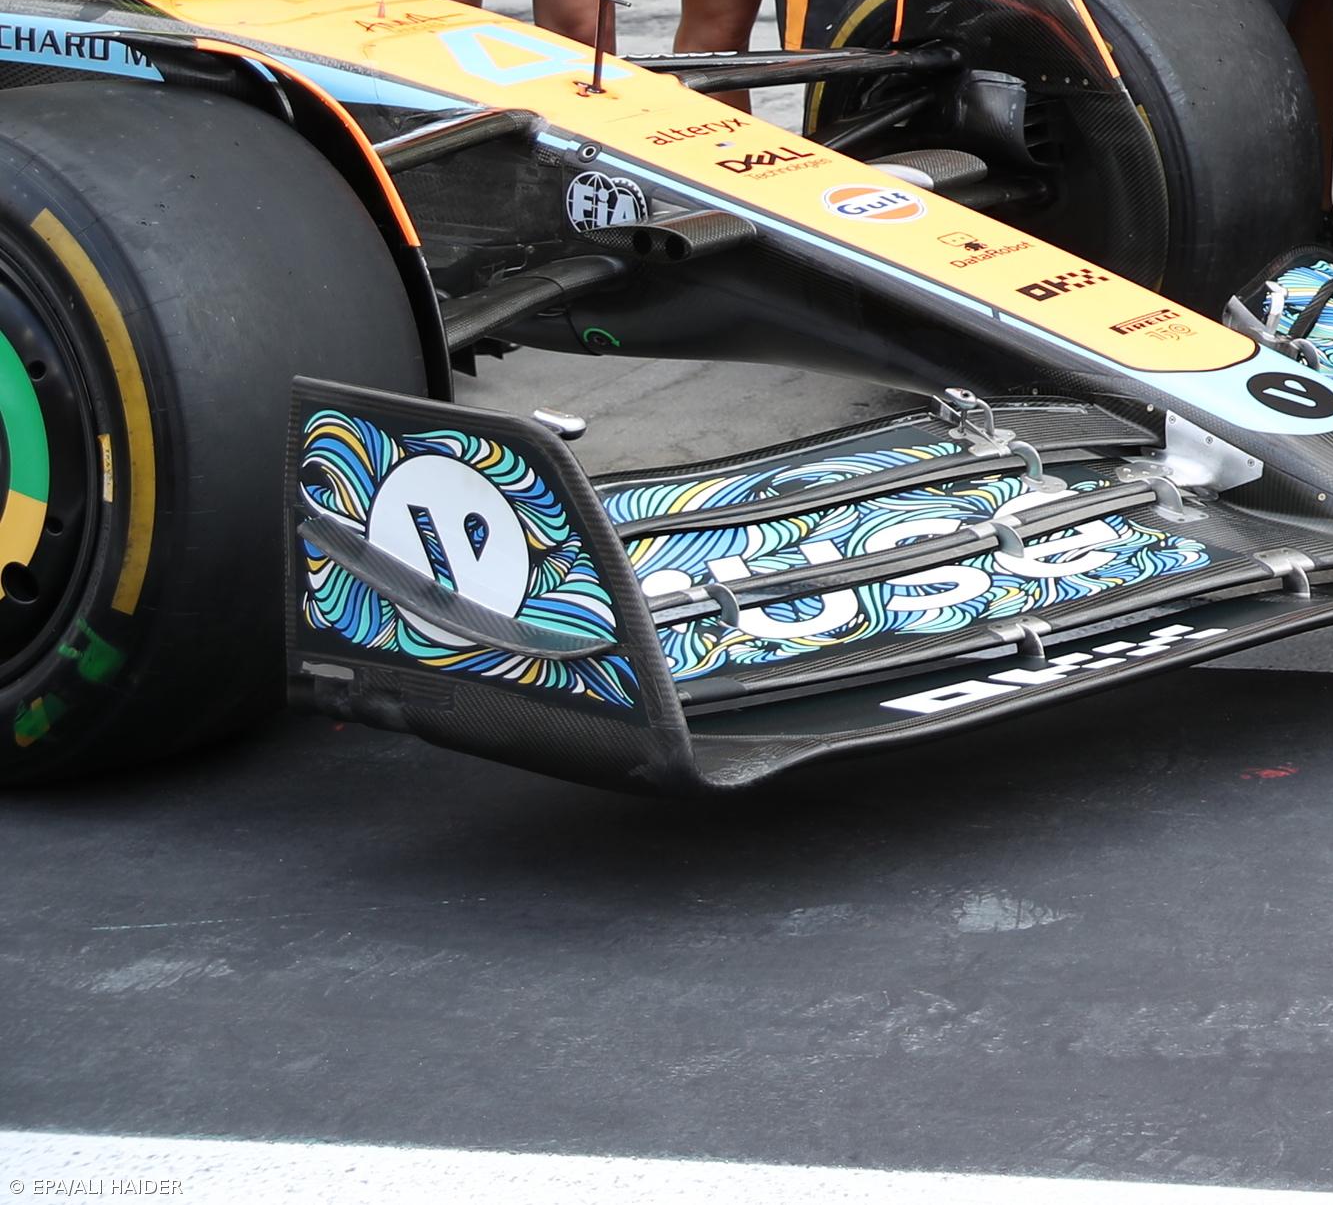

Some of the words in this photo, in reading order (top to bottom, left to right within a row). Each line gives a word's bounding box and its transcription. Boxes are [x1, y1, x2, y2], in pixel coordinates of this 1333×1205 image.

[645, 116, 751, 147] alteryx
[714, 145, 816, 175] DELL
[743, 156, 833, 183] Technologies
[835, 191, 919, 219] Gulf
[949, 240, 1036, 270] DataRobot
[1015, 267, 1111, 301] OKX
[1110, 308, 1181, 336] PIRELLI
